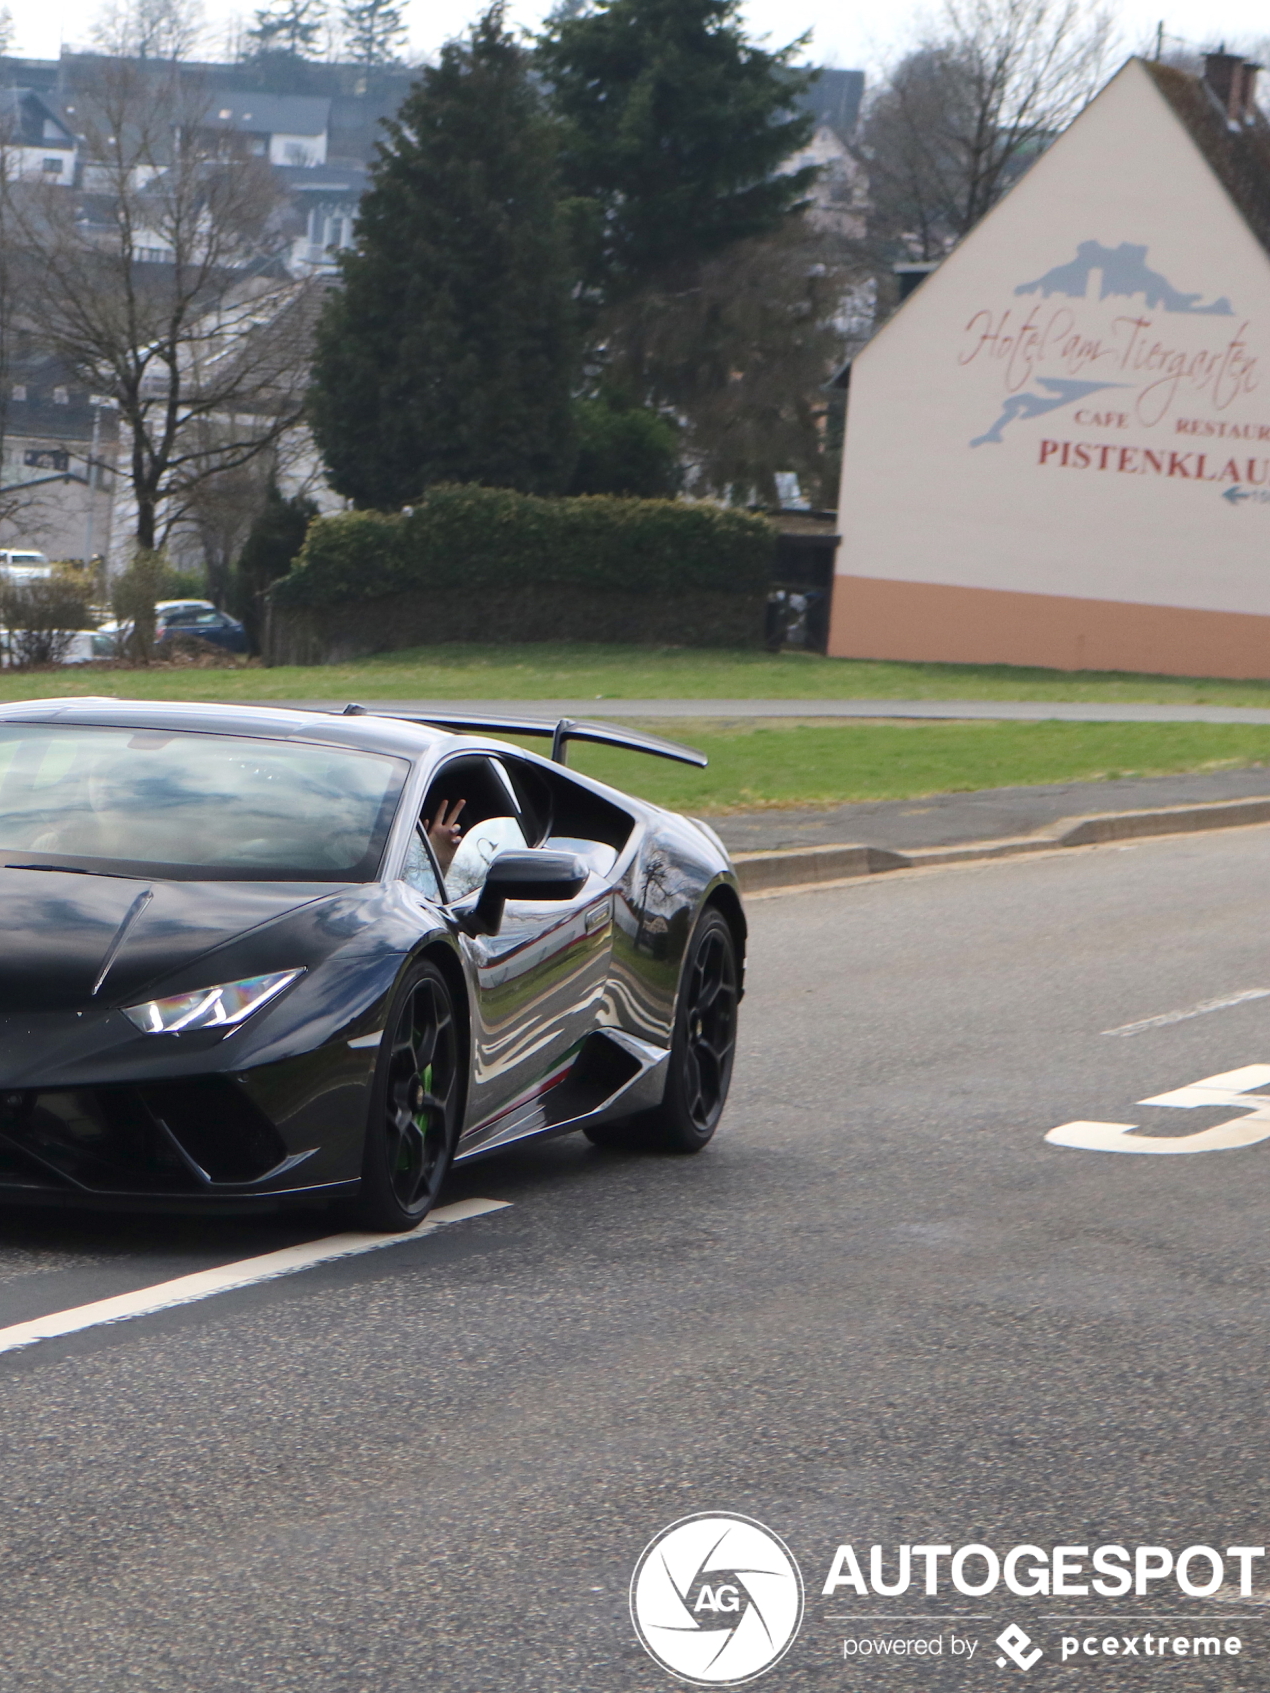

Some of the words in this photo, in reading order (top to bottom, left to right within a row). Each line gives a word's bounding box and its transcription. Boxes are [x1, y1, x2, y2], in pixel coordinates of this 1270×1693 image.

[958, 304, 1074, 393] Hotel
[1061, 333, 1114, 375] am
[1112, 315, 1258, 428] Tiergarten
[1074, 408, 1129, 429] CAFE
[1175, 417, 1270, 441] RESTAUR
